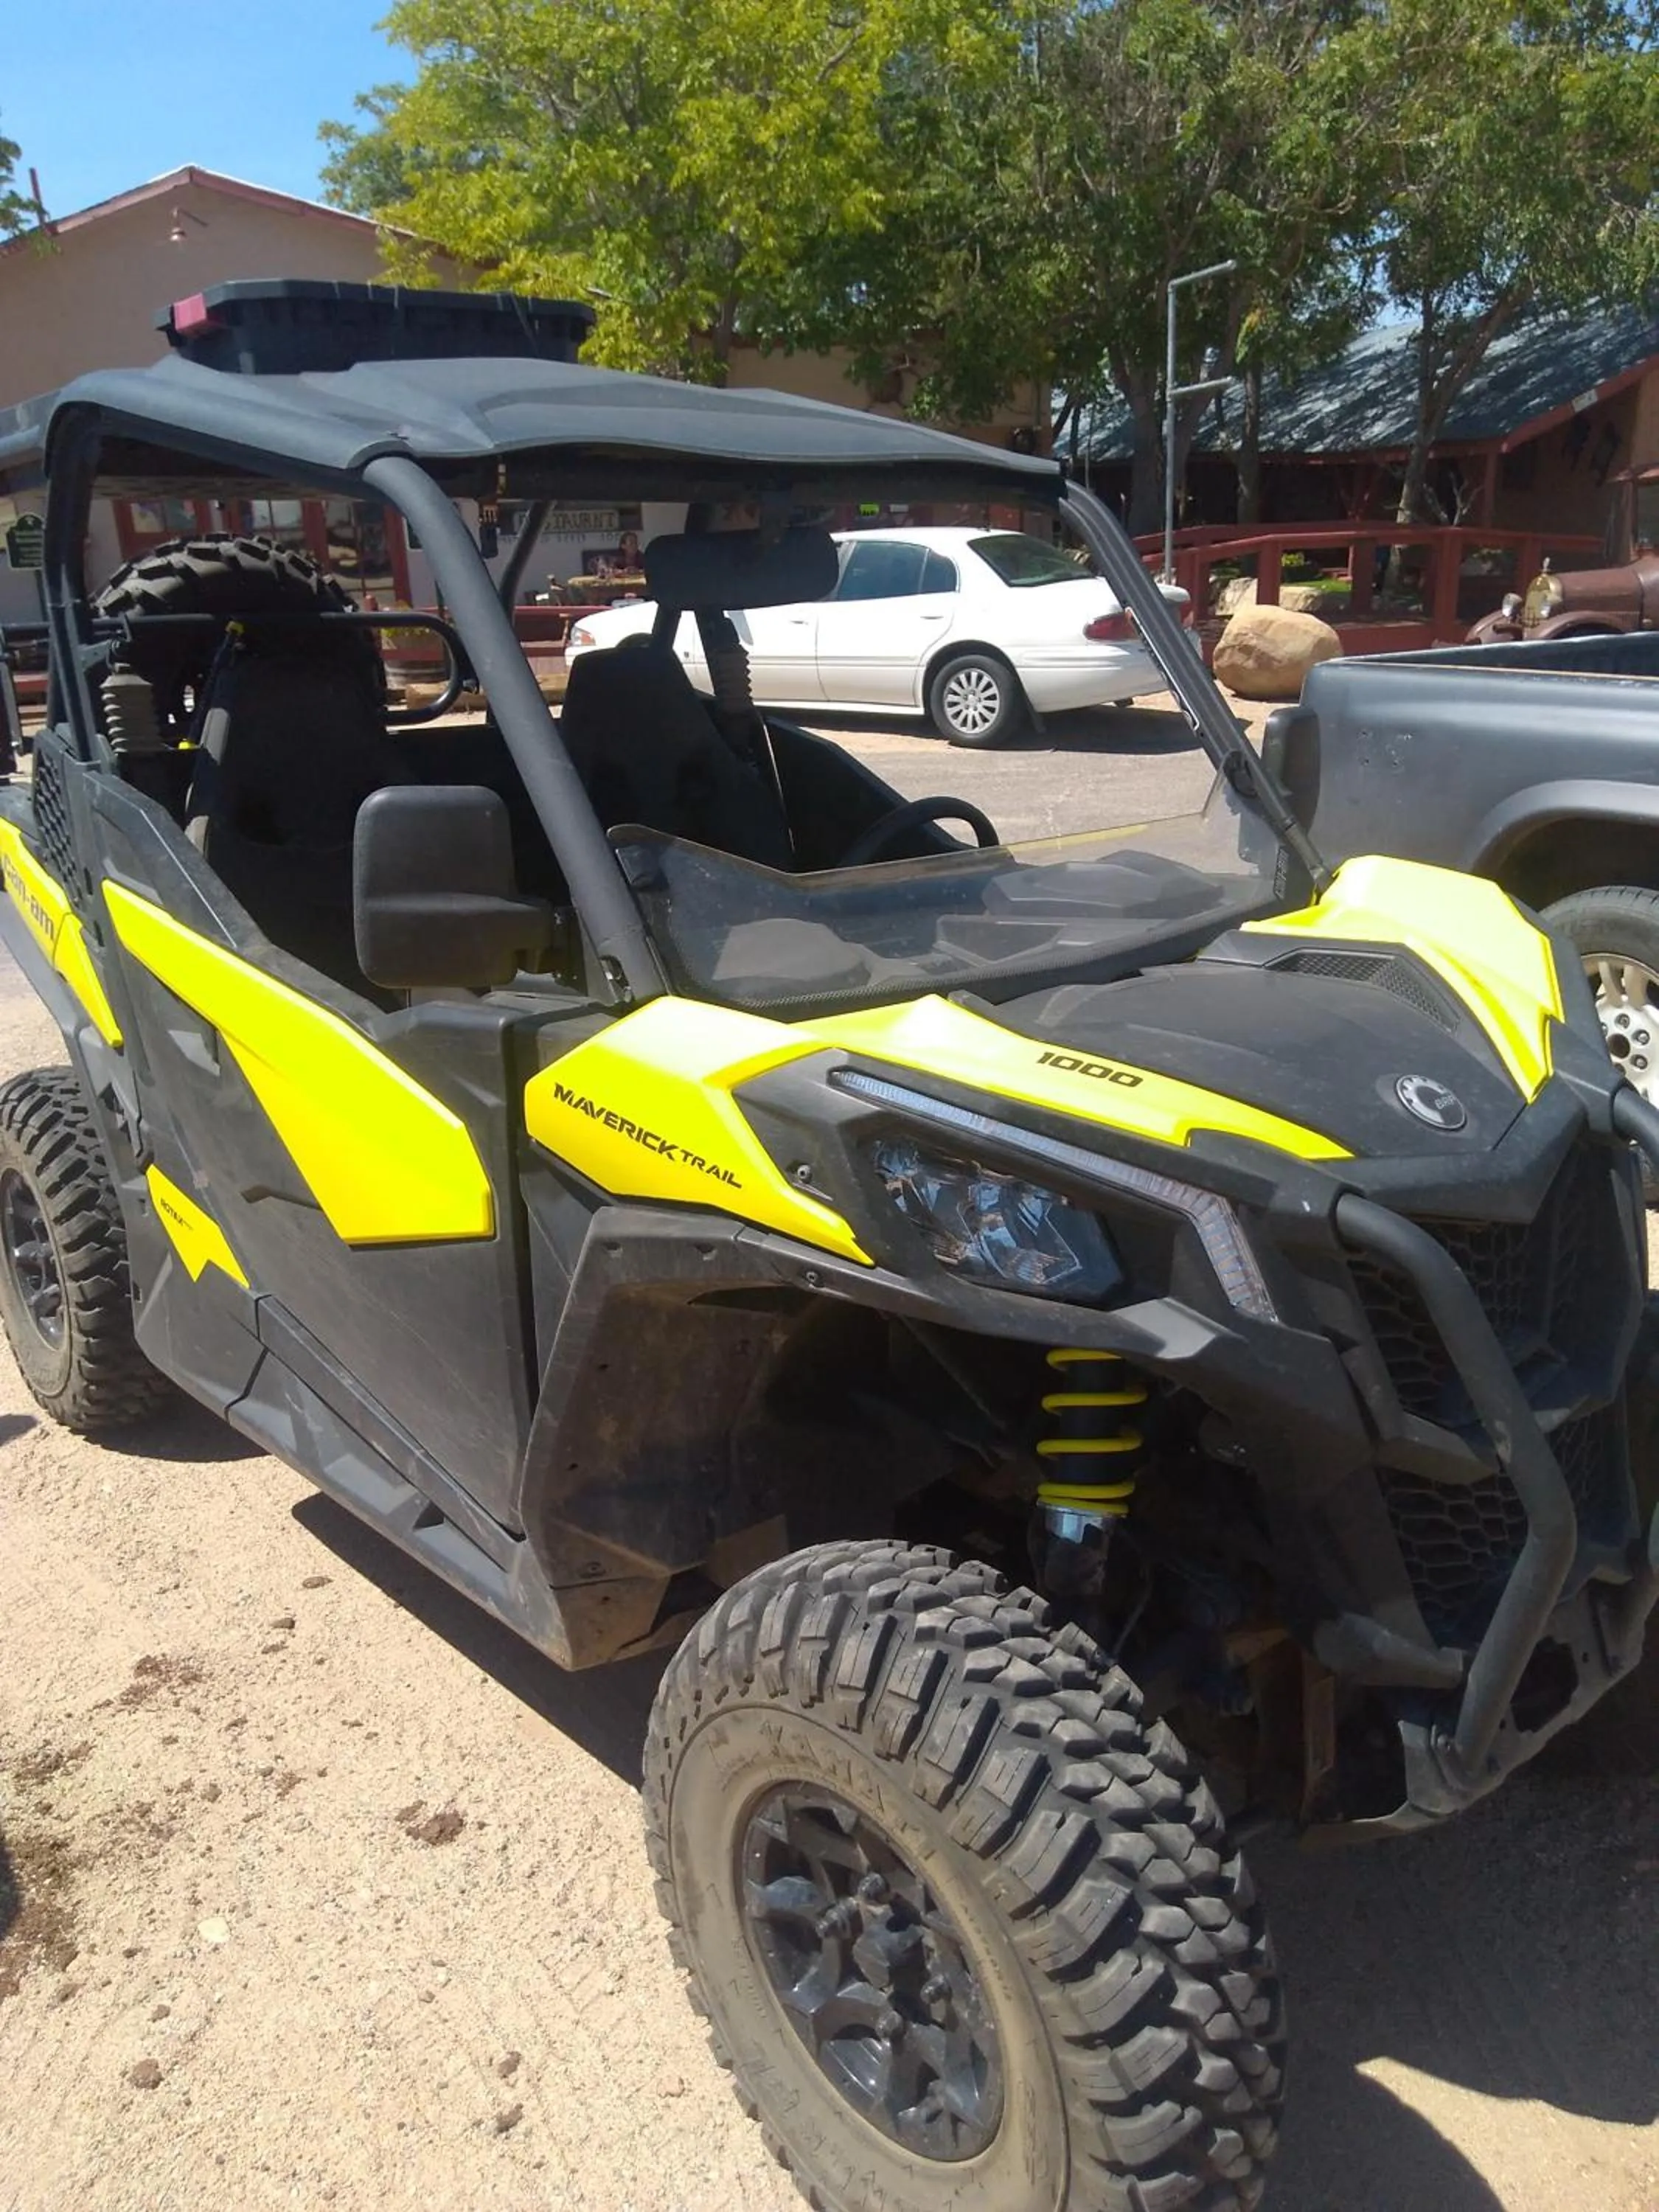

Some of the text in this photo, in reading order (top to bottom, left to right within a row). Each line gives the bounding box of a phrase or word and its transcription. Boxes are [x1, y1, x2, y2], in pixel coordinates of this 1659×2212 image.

[1037, 1051, 1144, 1088] 1000
[554, 1082, 742, 1189] MAVERICK TRAIL
